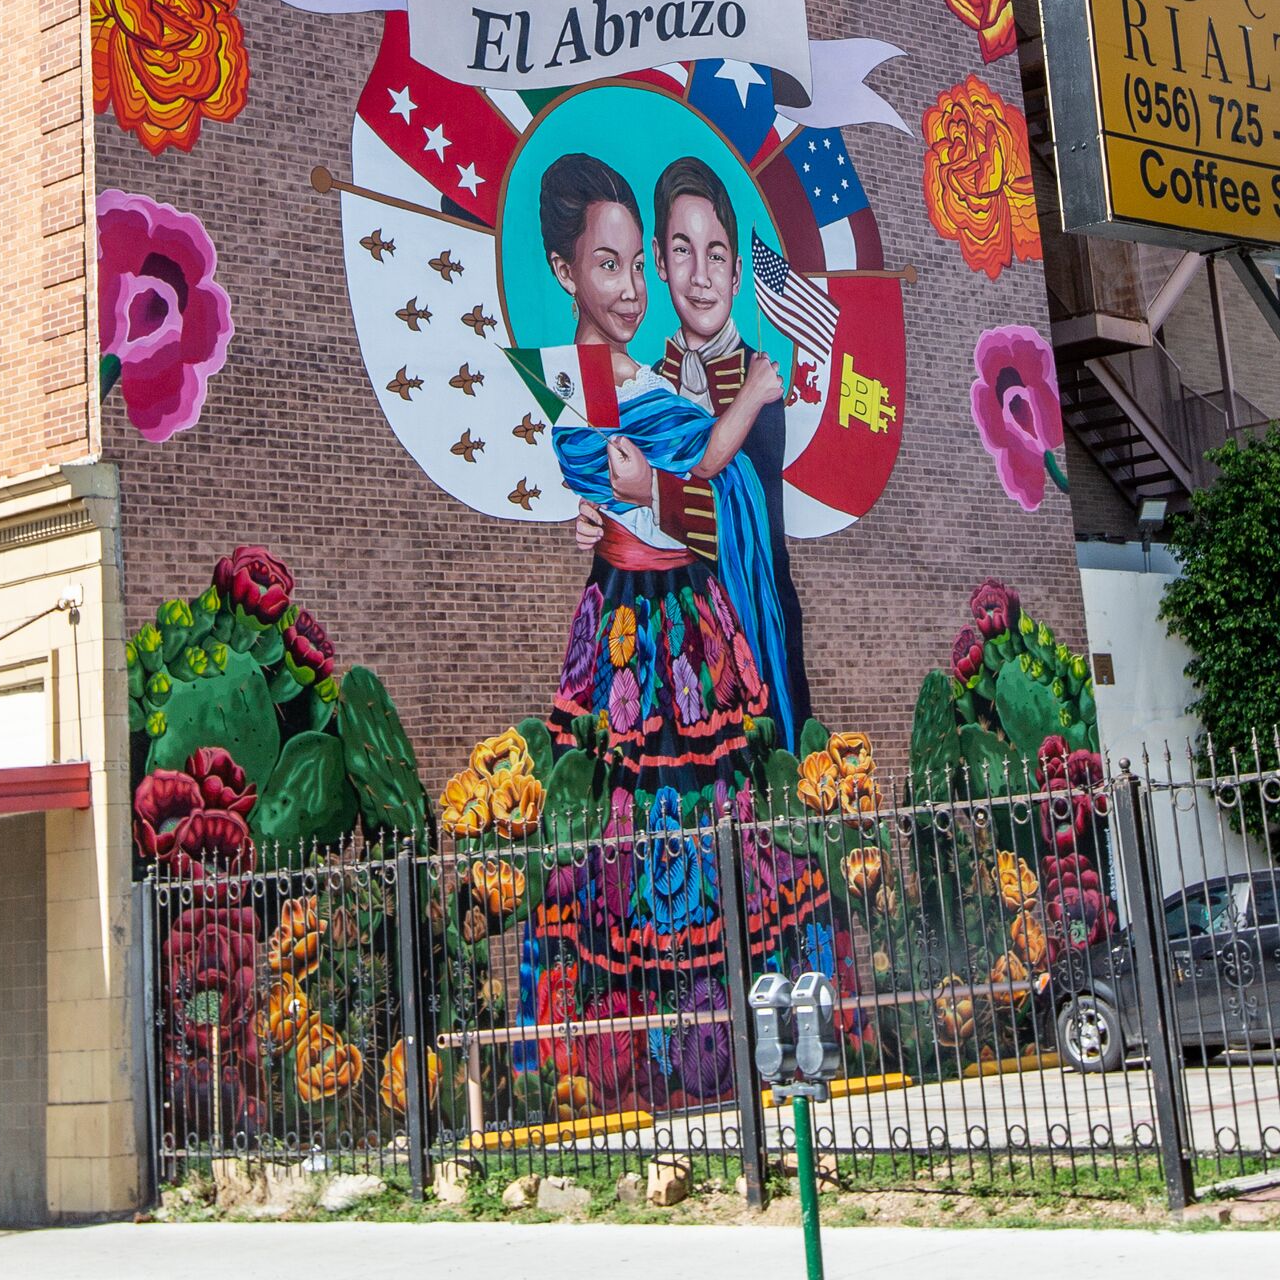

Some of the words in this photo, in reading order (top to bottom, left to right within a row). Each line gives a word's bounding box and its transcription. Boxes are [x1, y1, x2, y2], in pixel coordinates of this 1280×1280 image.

[467, 7, 534, 73] El
[1124, 73, 1200, 146] (956)
[1209, 94, 1263, 147] 725
[1140, 149, 1261, 216] Coffee
